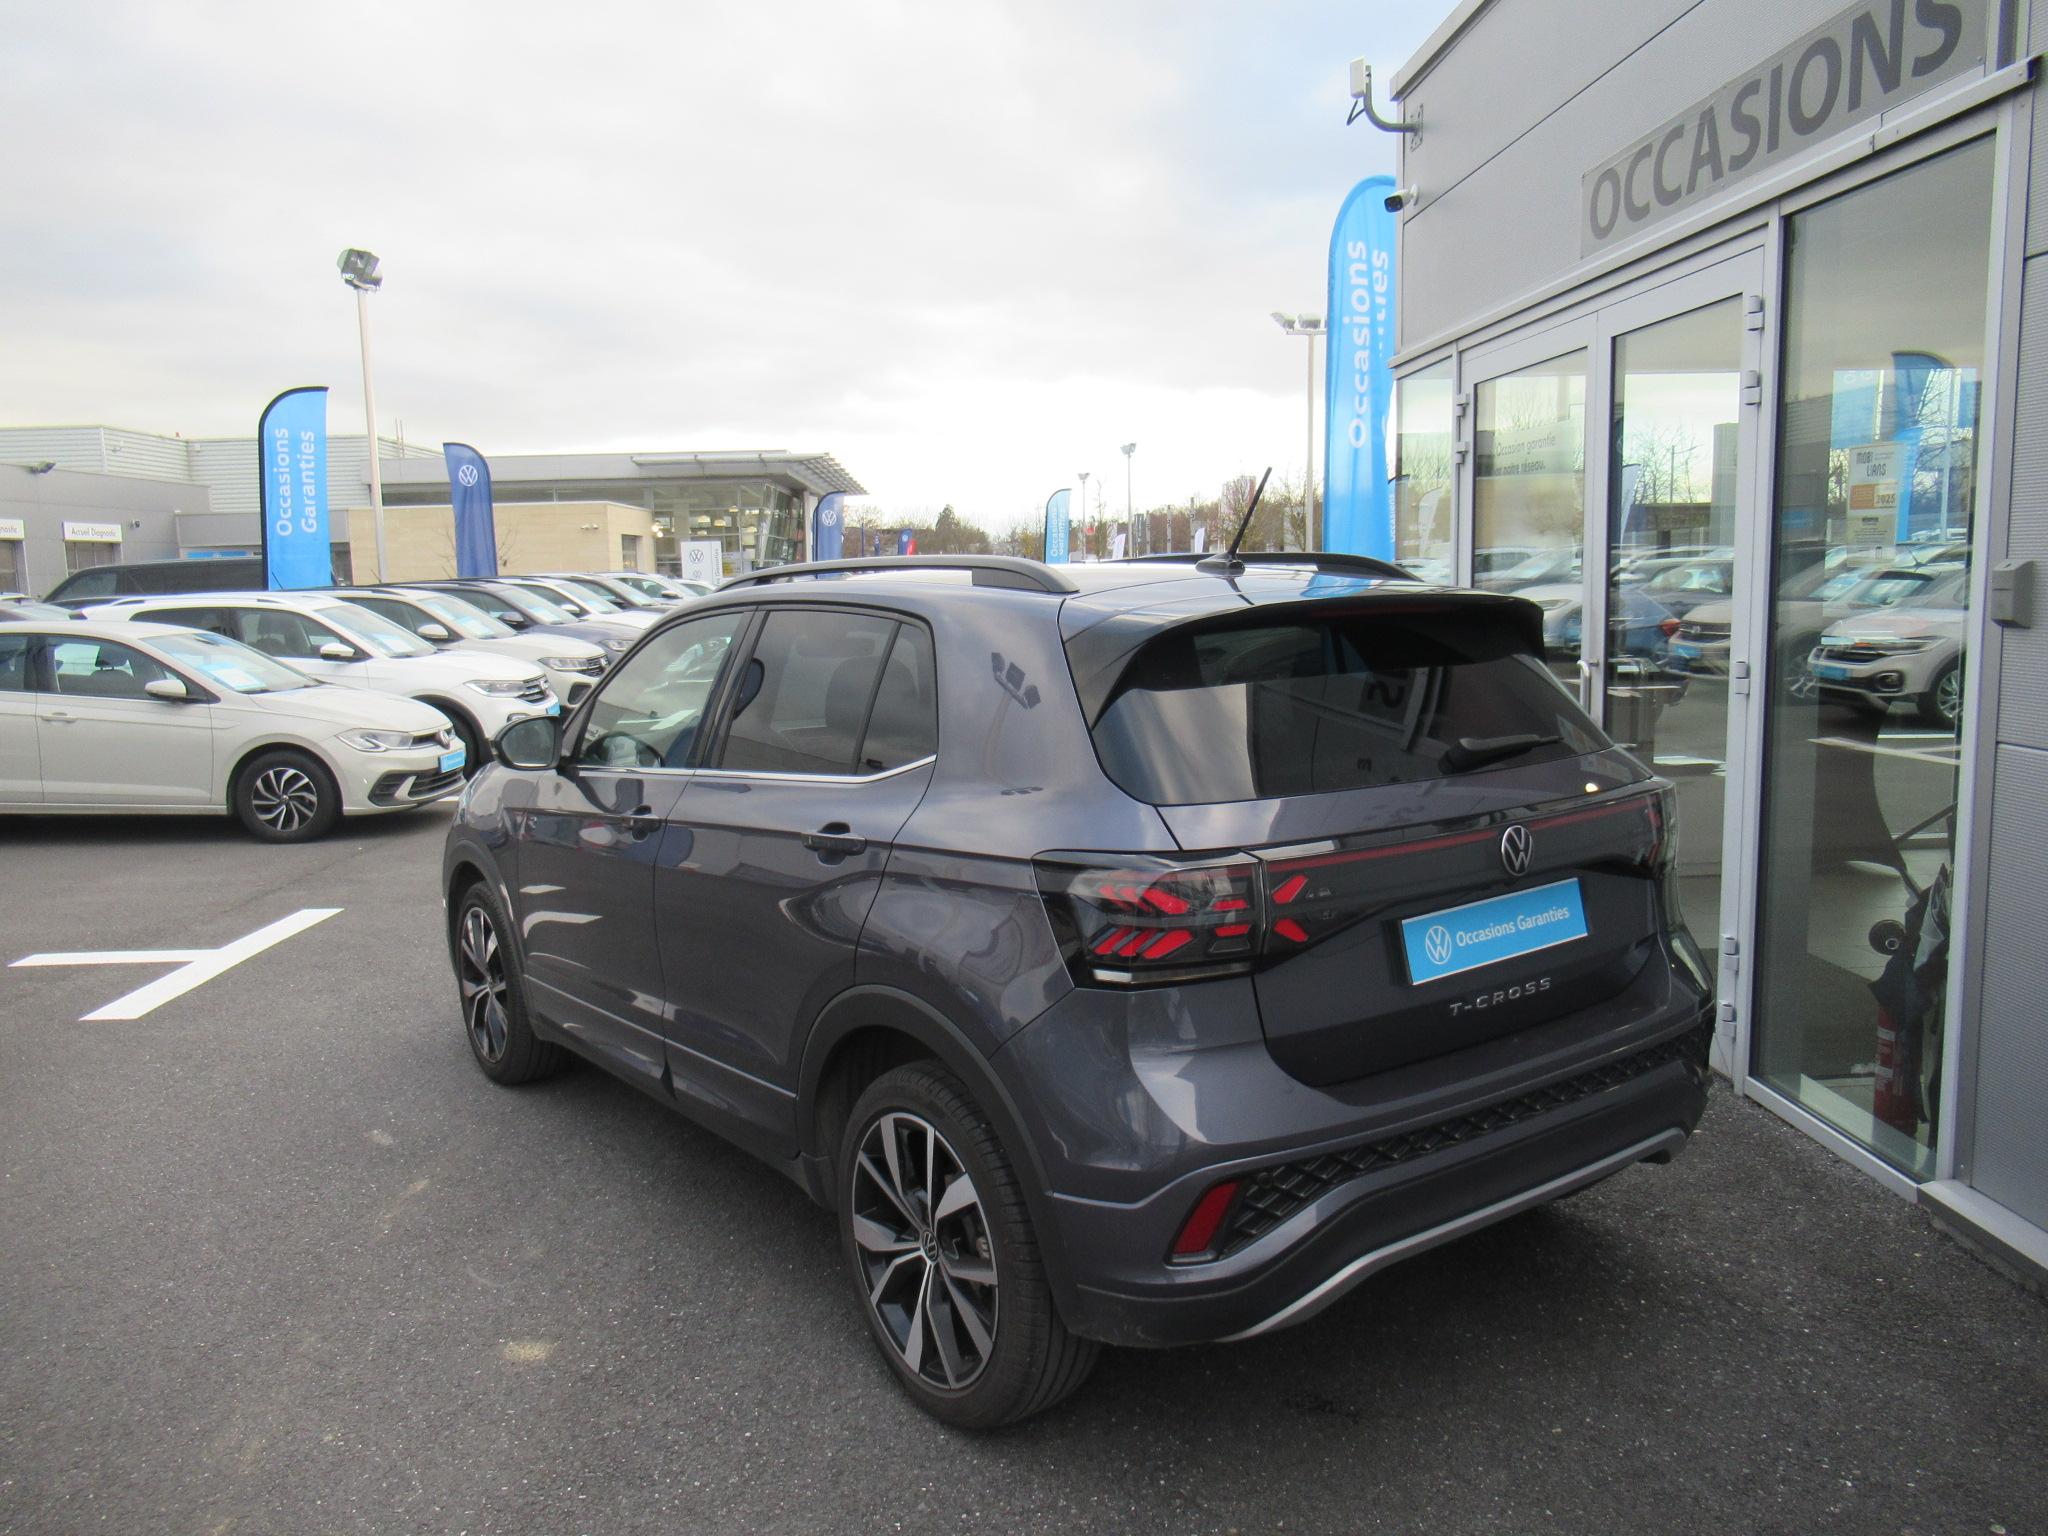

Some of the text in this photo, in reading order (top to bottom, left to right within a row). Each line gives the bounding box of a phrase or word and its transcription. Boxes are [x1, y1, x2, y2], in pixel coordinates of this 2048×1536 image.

[1589, 0, 1963, 240] OCCASIONS
[1343, 240, 1371, 449] Occasions
[273, 427, 293, 537] Occasions
[297, 430, 317, 534] Garanties
[1496, 432, 1556, 456] Occasion garantie
[1456, 920, 1515, 948] Occasions
[1517, 906, 1570, 931] Garanties
[1449, 977, 1553, 1017] T-CROSS
